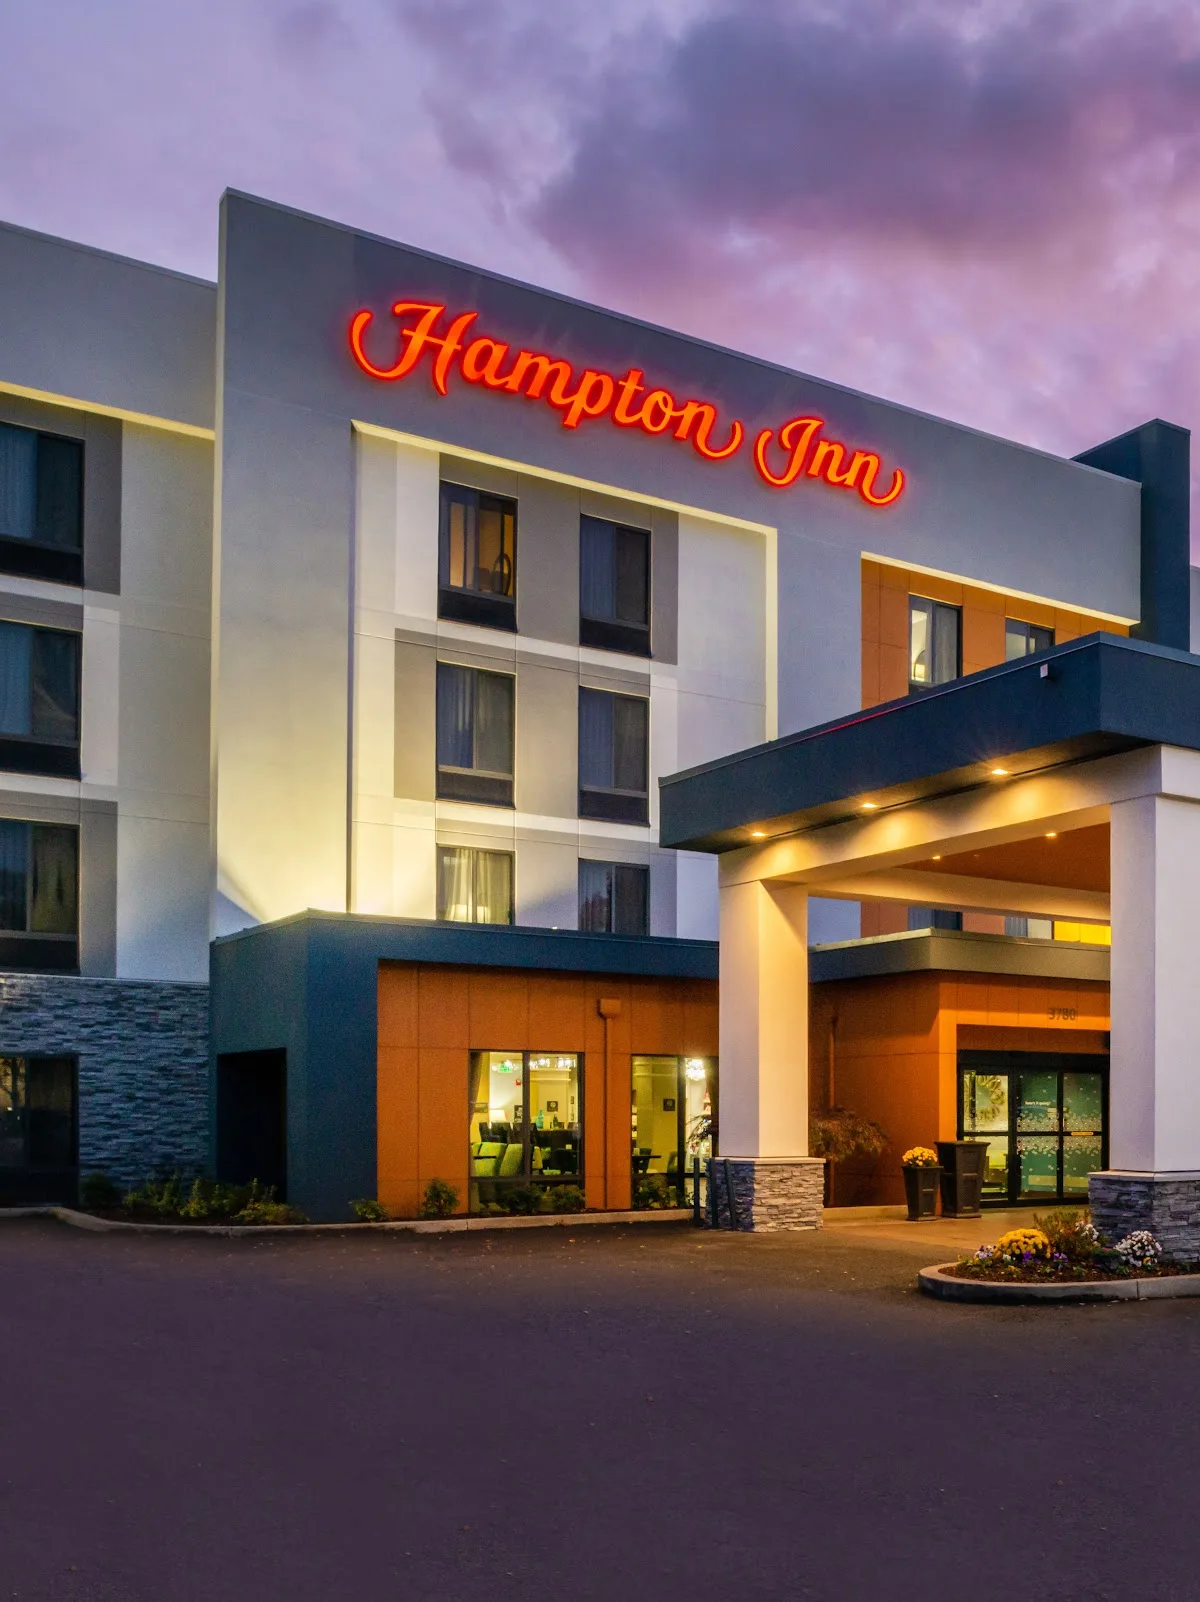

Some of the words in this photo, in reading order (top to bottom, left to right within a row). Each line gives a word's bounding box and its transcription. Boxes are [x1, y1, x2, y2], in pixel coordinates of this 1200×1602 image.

[350, 302, 743, 459] Hampton
[755, 416, 905, 505] Inn
[1048, 1007, 1076, 1021] 3780
